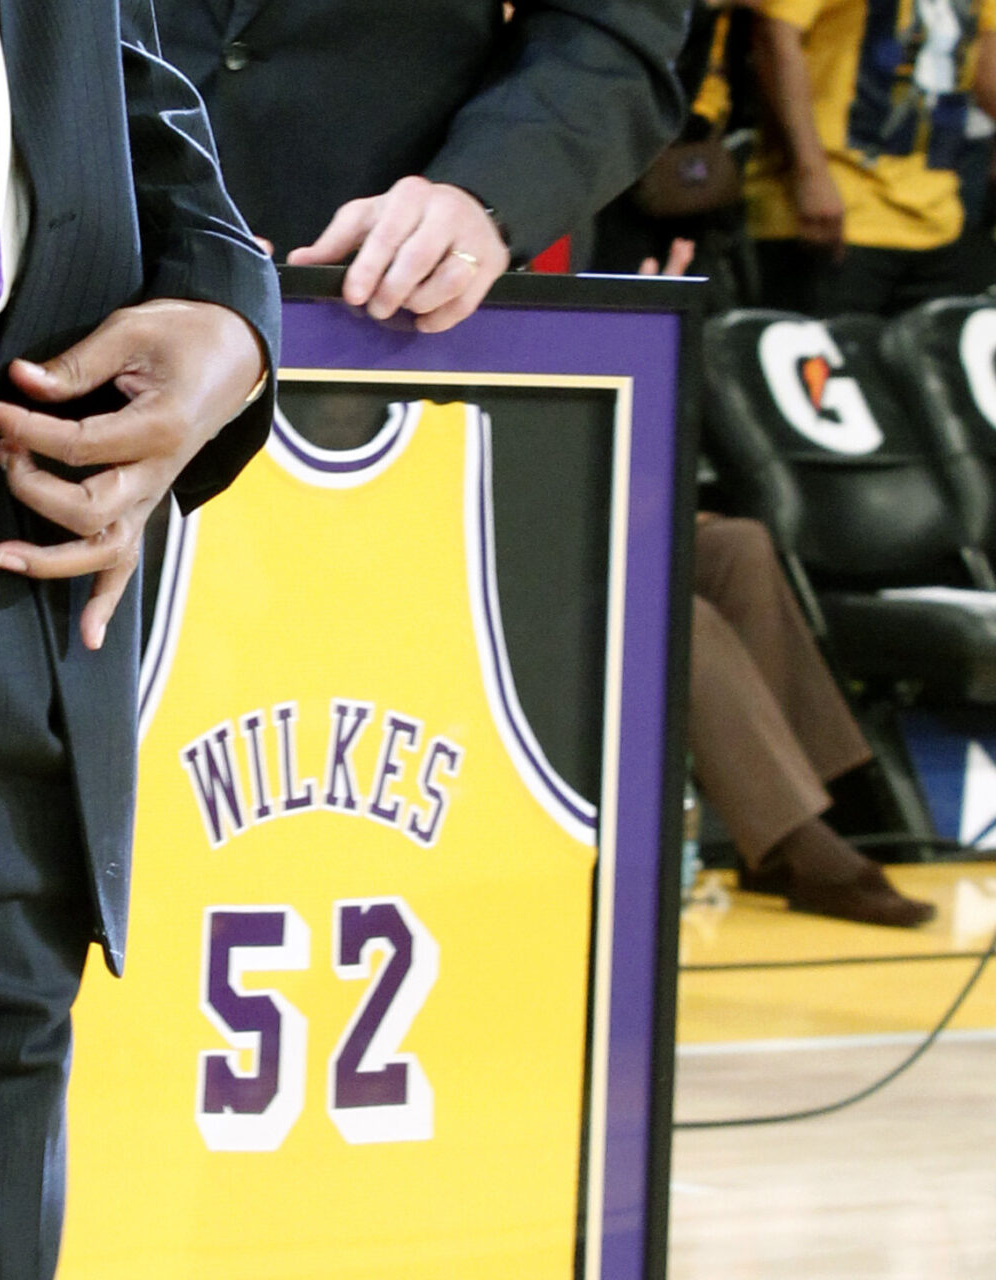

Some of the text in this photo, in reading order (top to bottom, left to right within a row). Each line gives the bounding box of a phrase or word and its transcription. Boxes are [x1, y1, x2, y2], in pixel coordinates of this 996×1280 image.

[758, 320, 884, 455] G
[181, 699, 464, 847] WILKES
[196, 897, 438, 1149] 52
